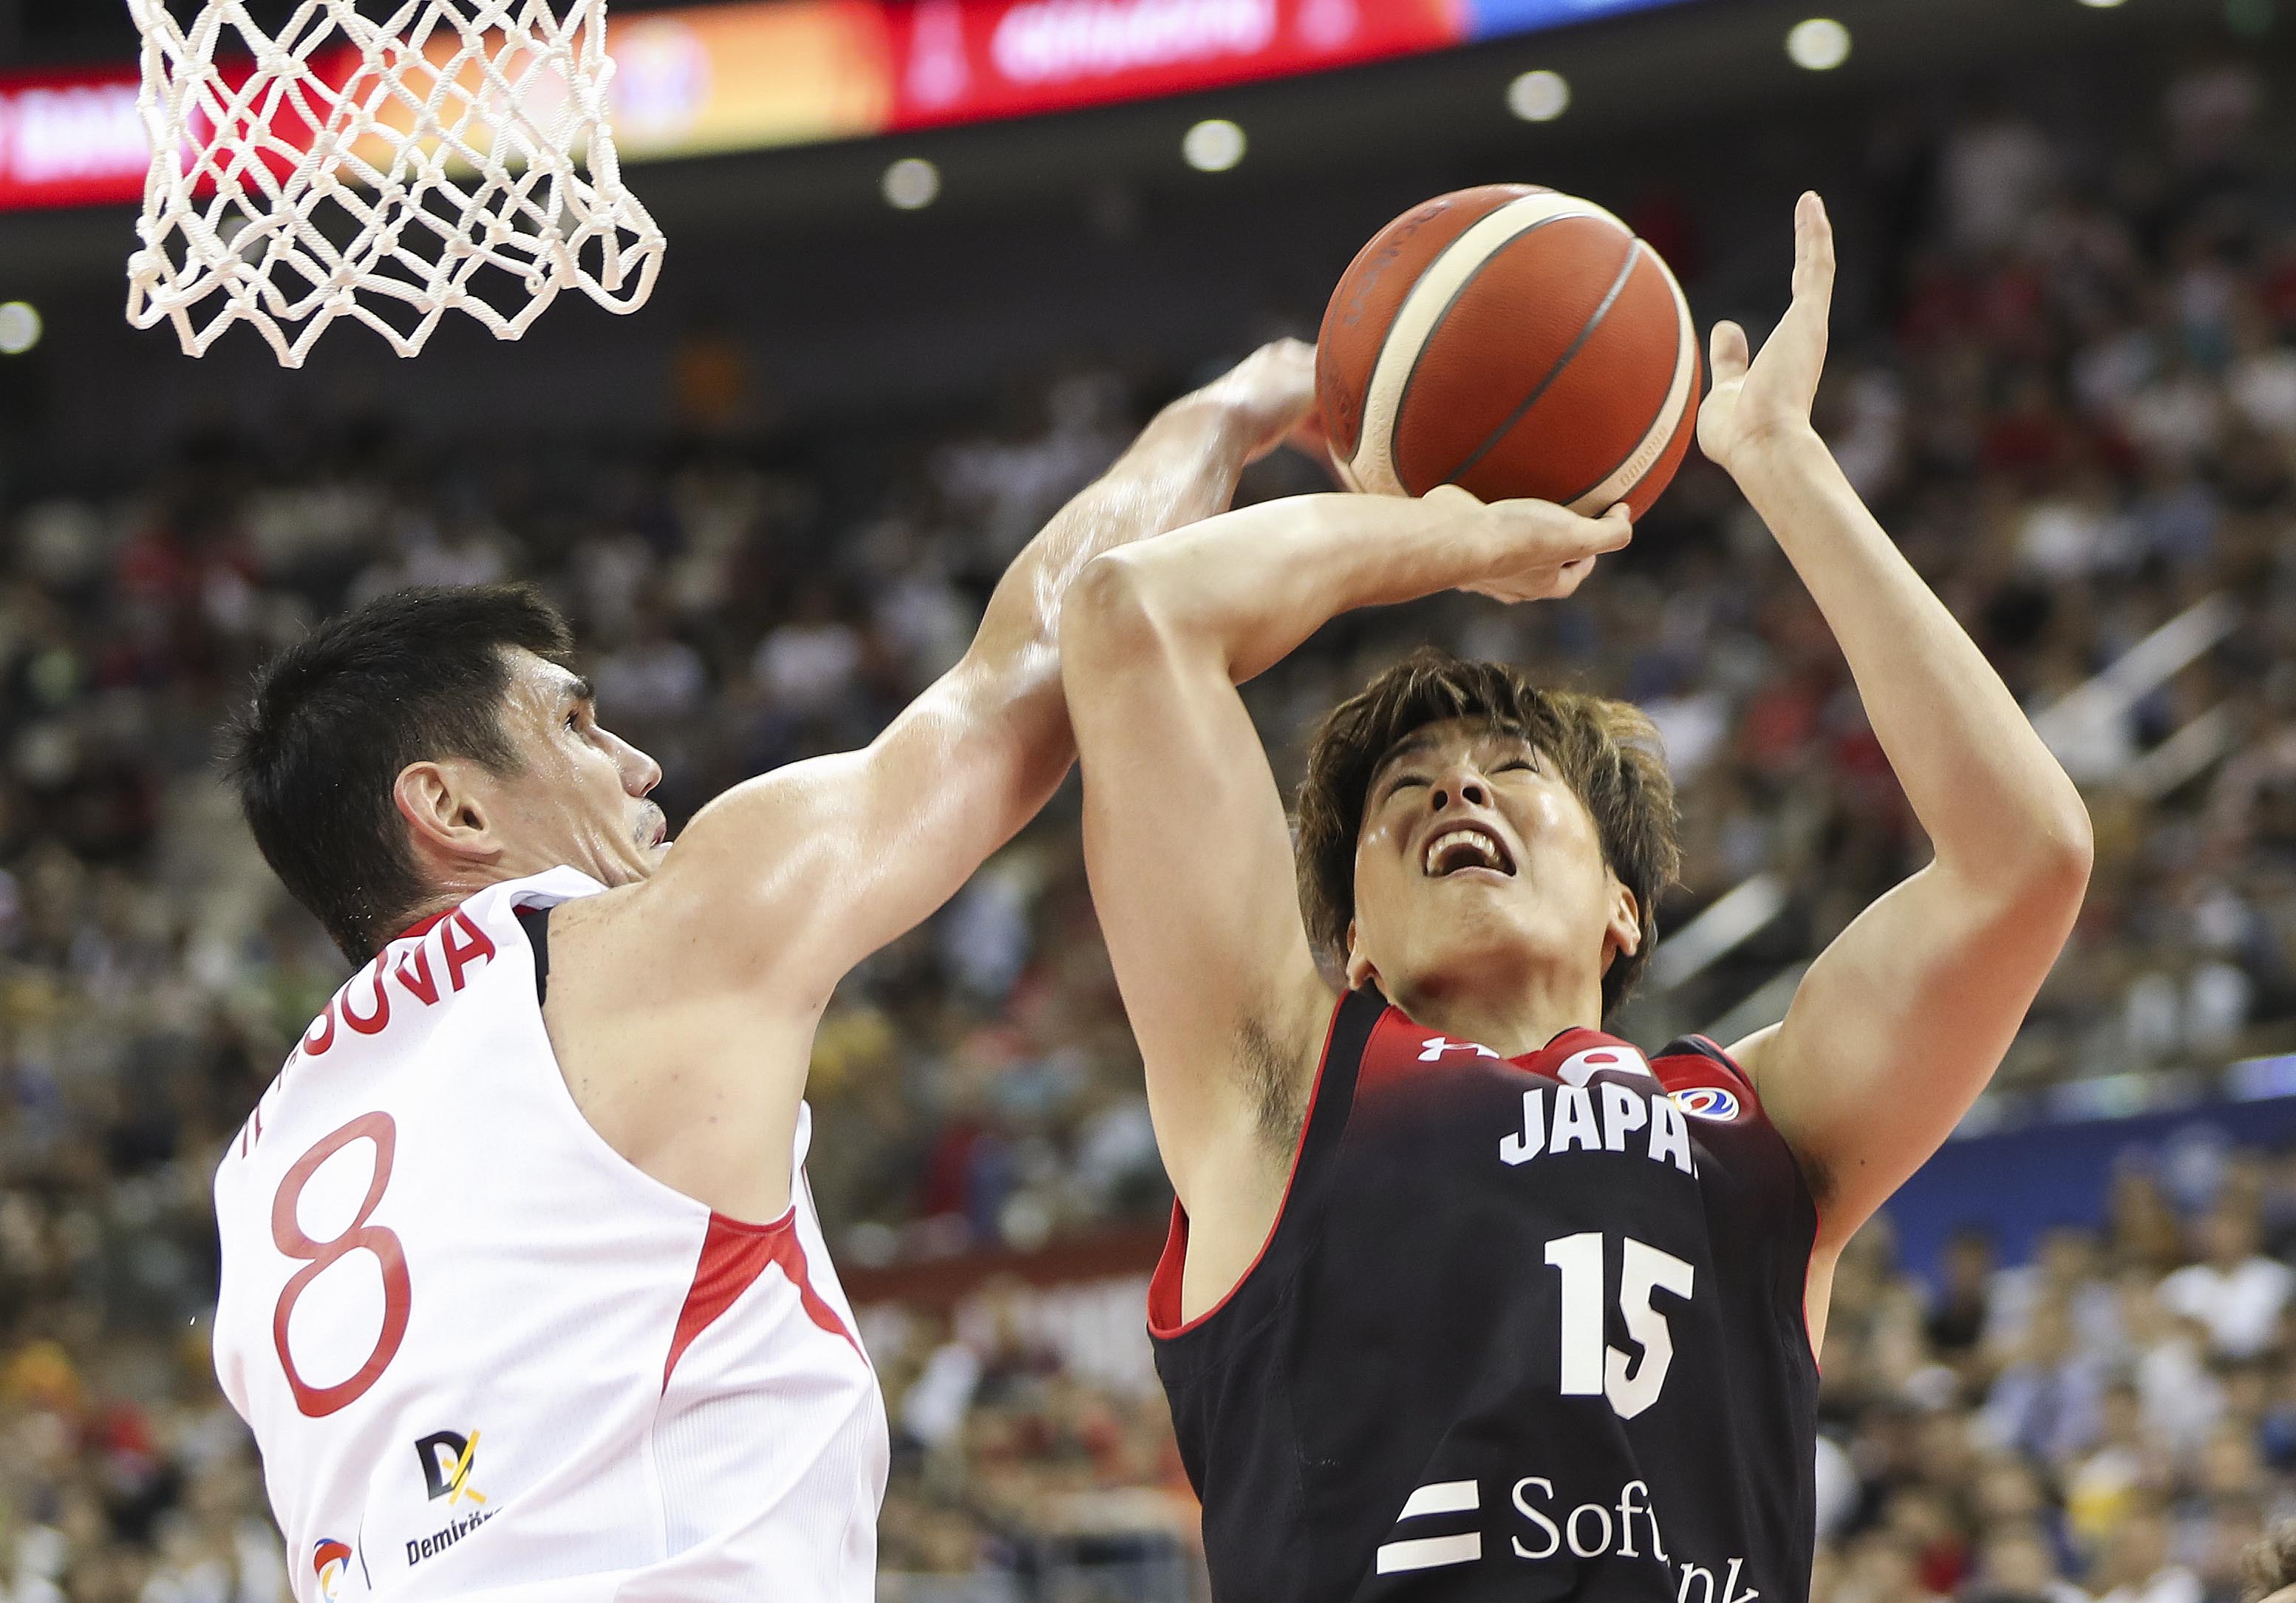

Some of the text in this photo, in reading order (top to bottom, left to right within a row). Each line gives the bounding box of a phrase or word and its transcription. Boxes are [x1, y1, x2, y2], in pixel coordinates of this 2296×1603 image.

[1499, 1082, 1698, 1180] JAPA
[272, 1111, 412, 1417] 8
[1544, 1232, 1694, 1420] 15
